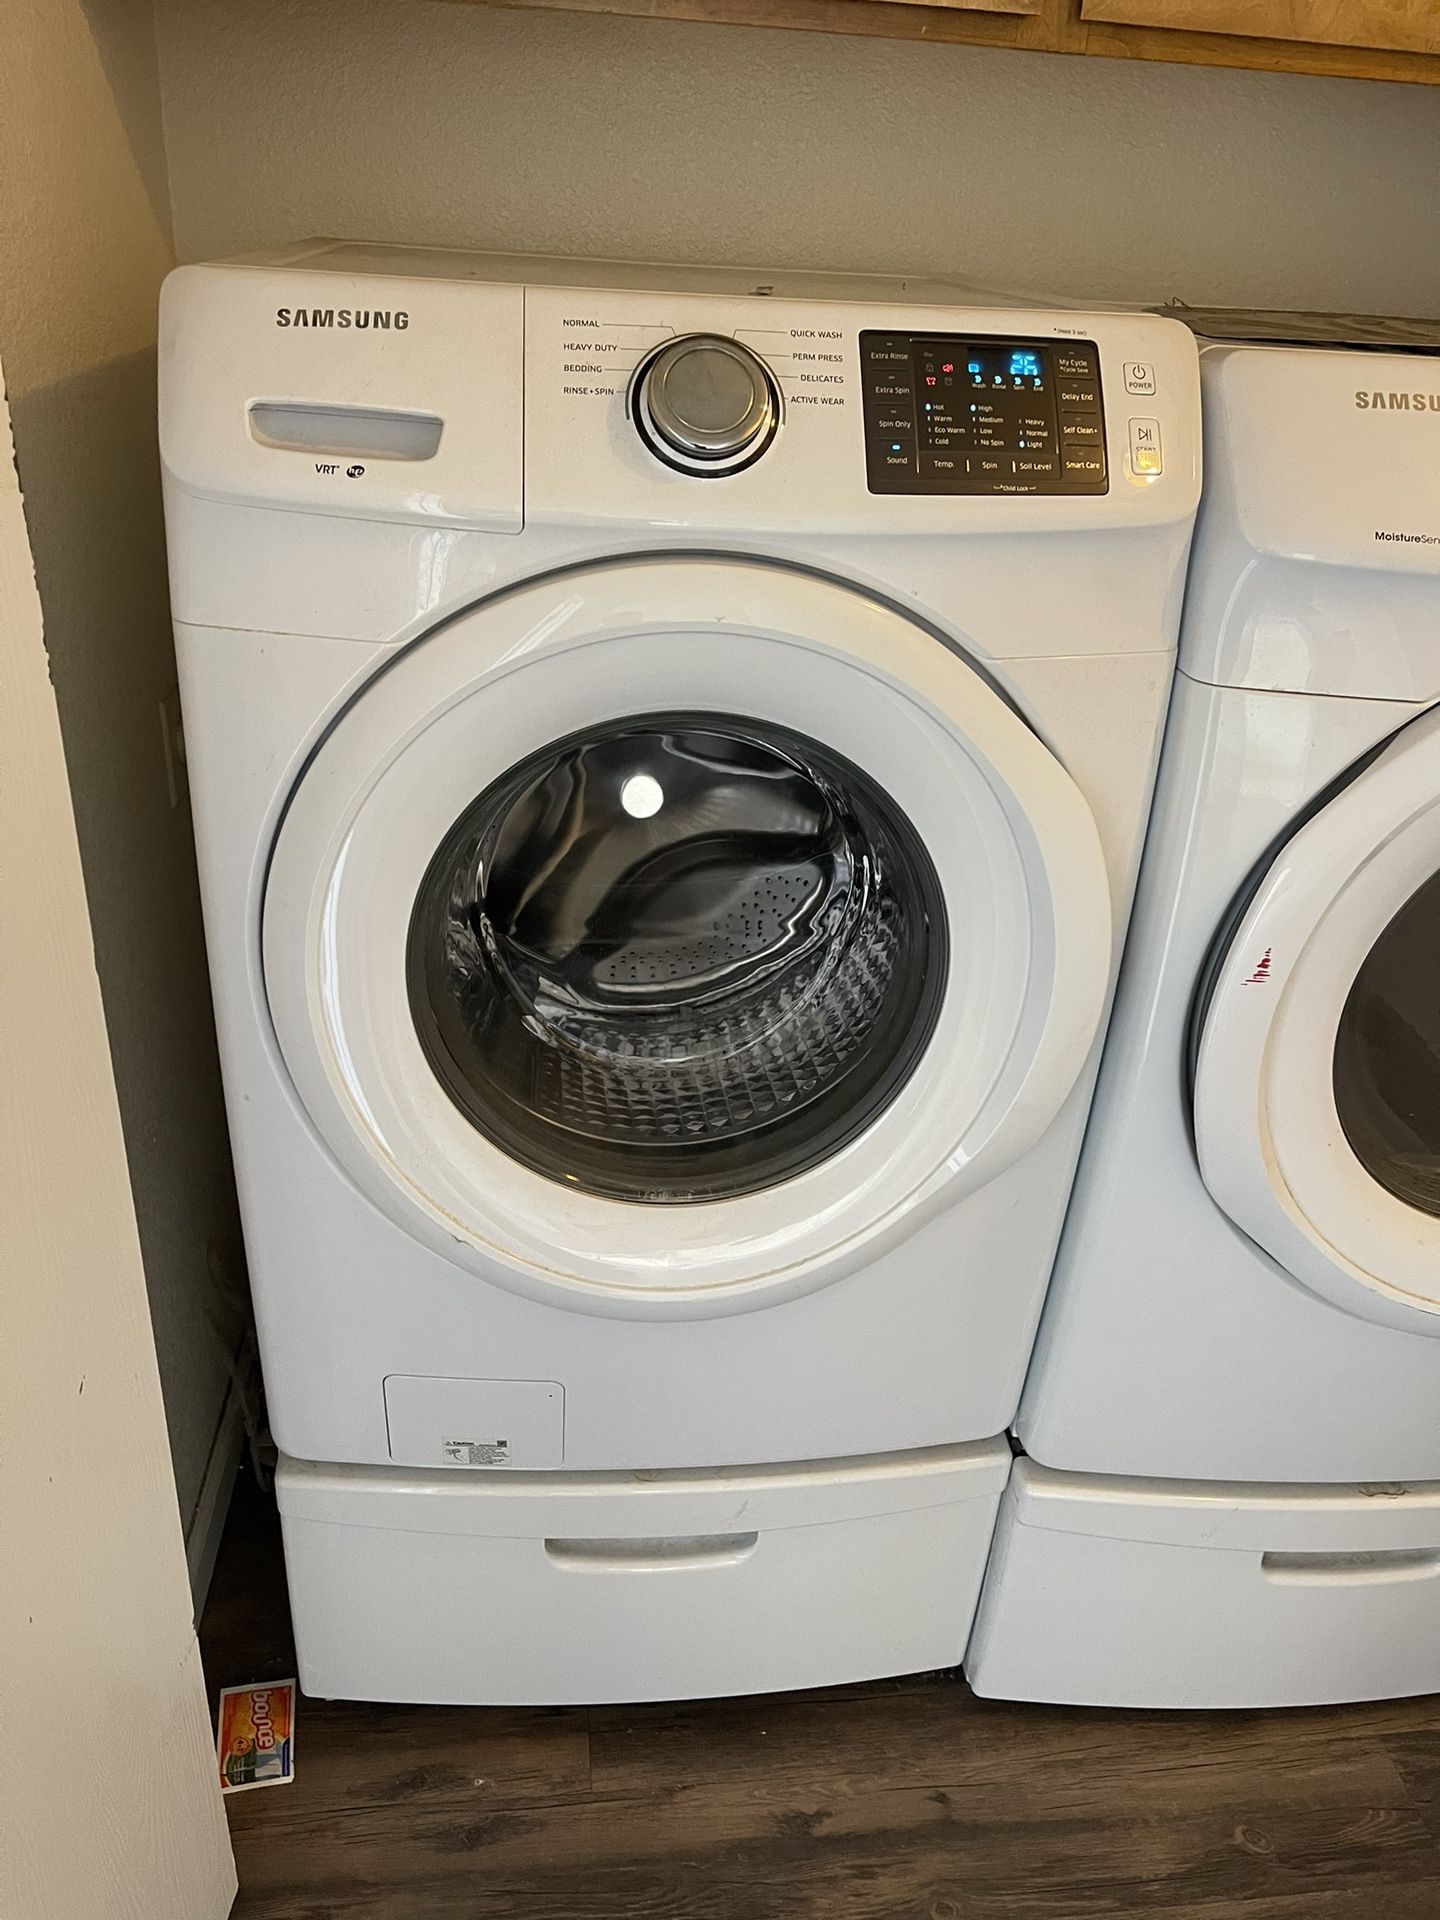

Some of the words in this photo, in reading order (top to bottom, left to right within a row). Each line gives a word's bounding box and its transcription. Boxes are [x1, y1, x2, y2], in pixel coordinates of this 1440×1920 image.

[276, 308, 410, 330] SAMSUNG
[562, 319, 600, 327] NORMAL
[790, 329, 816, 338] QUICK
[818, 330, 843, 339] WASH
[563, 343, 592, 352] HEAVY
[594, 344, 618, 352] DUTY
[792, 352, 815, 361] PERM
[818, 353, 844, 362] PRESS
[870, 352, 889, 360] Extra
[1059, 359, 1070, 367] My
[1070, 360, 1088, 368] Cycle
[563, 364, 602, 373] BEDDING
[800, 374, 844, 383] DELICATES
[1128, 381, 1153, 389] POWER
[875, 386, 894, 394] Extra
[895, 386, 910, 395] Spin
[790, 396, 818, 405] ACTIVE
[821, 397, 845, 406] WEAR
[1062, 393, 1080, 401] Delay
[1081, 393, 1093, 401] End
[979, 404, 994, 413] High
[879, 420, 894, 429] Spin
[895, 420, 912, 430] Only
[1025, 418, 1045, 427] Heavy
[1026, 430, 1049, 438] Normal
[1063, 426, 1075, 434] Self
[990, 440, 1005, 448] Spin
[1027, 441, 1043, 449] Light
[887, 456, 908, 464] Sound
[982, 461, 998, 470] Spin
[1034, 463, 1052, 471] Level
[1066, 461, 1085, 469] Smart
